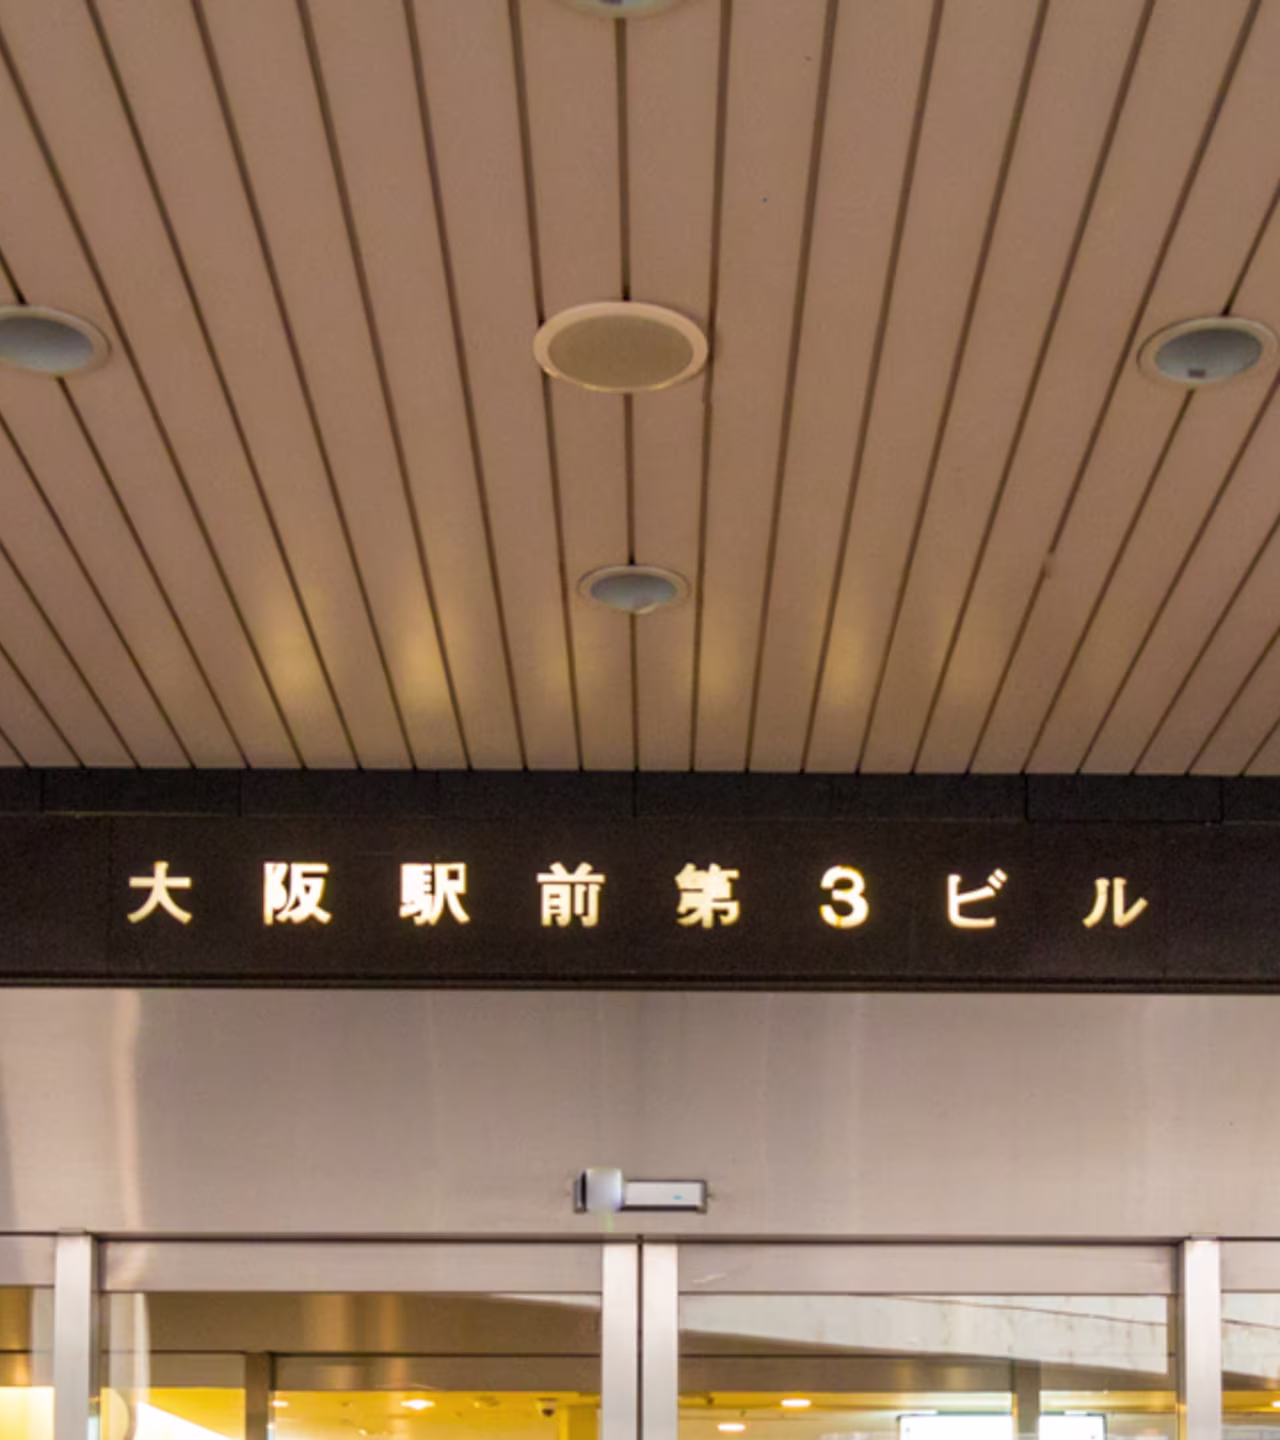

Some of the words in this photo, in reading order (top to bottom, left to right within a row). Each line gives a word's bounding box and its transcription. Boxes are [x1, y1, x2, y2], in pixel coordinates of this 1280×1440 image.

[126, 860, 1149, 930] 大阪駅前第3ビル
